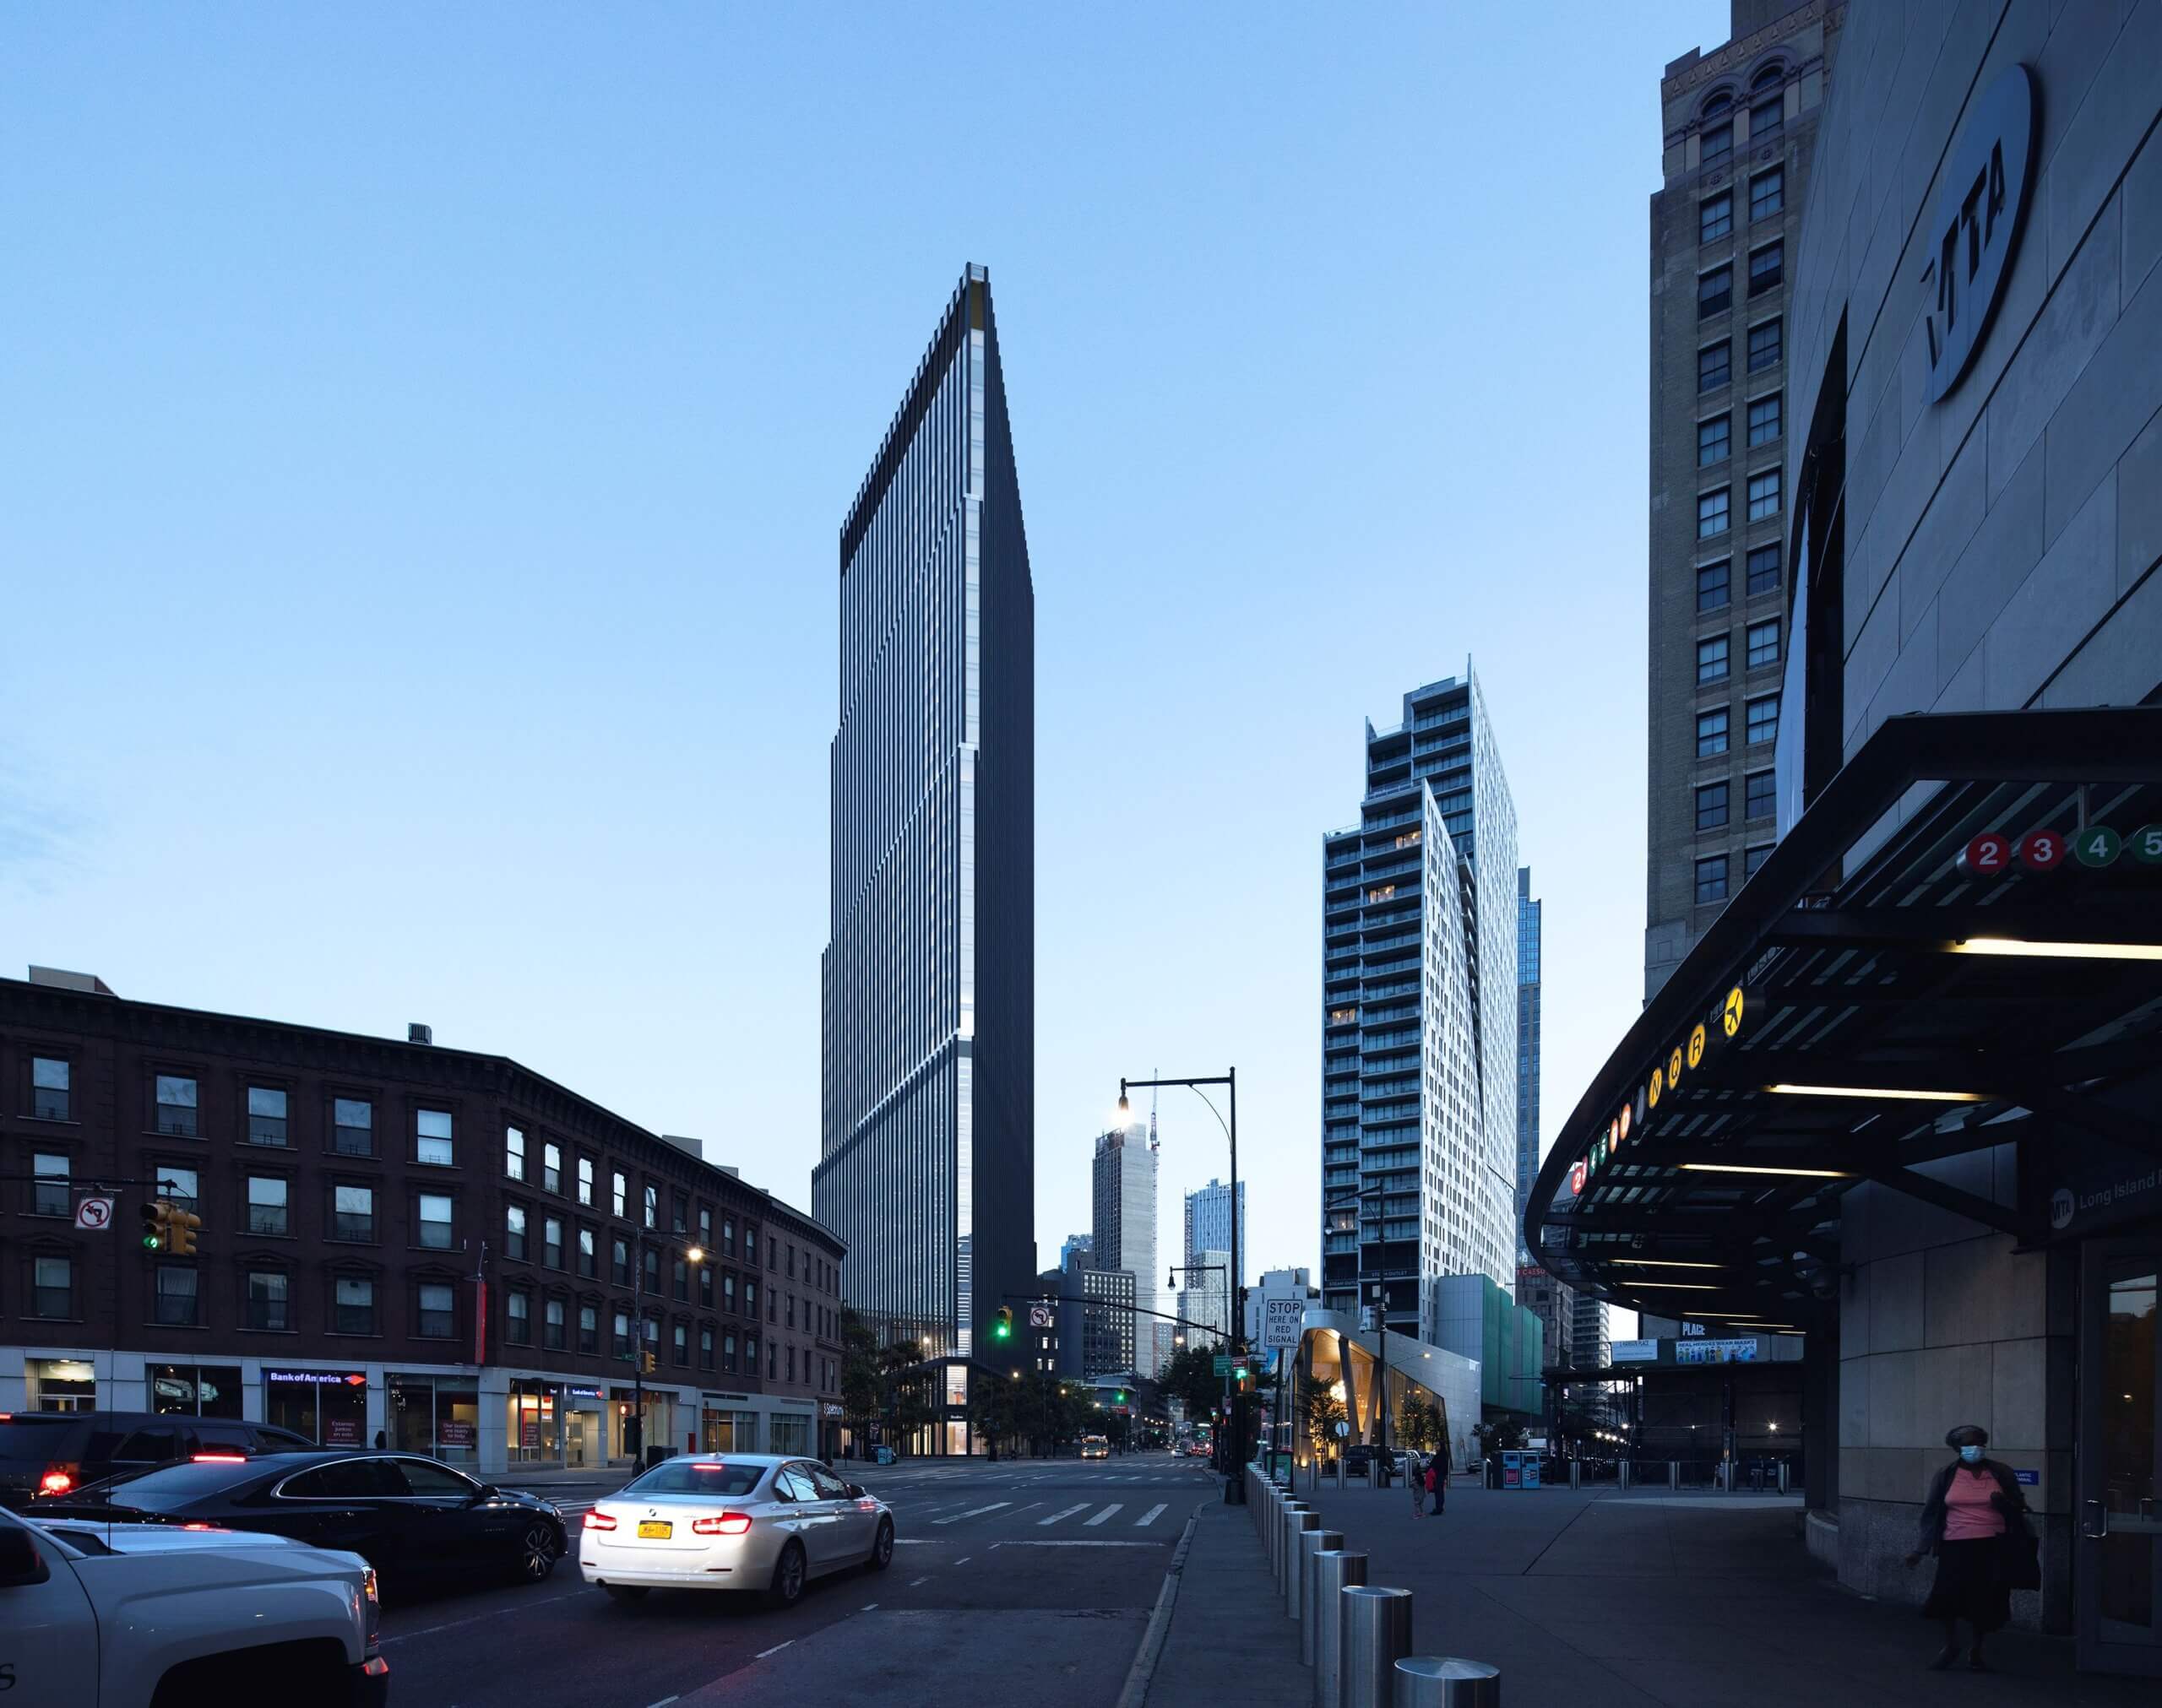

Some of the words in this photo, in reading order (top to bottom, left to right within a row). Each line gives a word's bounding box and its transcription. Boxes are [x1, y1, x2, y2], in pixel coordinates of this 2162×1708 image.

[1920, 137, 2005, 371] MTA
[1979, 841, 1999, 865] 2
[2033, 838, 2053, 862] 3
[2088, 834, 2108, 858] 4
[2143, 831, 2162, 856] 5
[1652, 1074, 1660, 1101] N
[1671, 1055, 1679, 1080] Q
[1692, 1033, 1701, 1061] R
[2080, 1189, 2111, 1210] Long
[2114, 1170, 2156, 1199] Island
[1269, 1303, 1300, 1314] STOP
[270, 1372, 295, 1381] Bank
[295, 1373, 305, 1382] of
[305, 1373, 341, 1384] America
